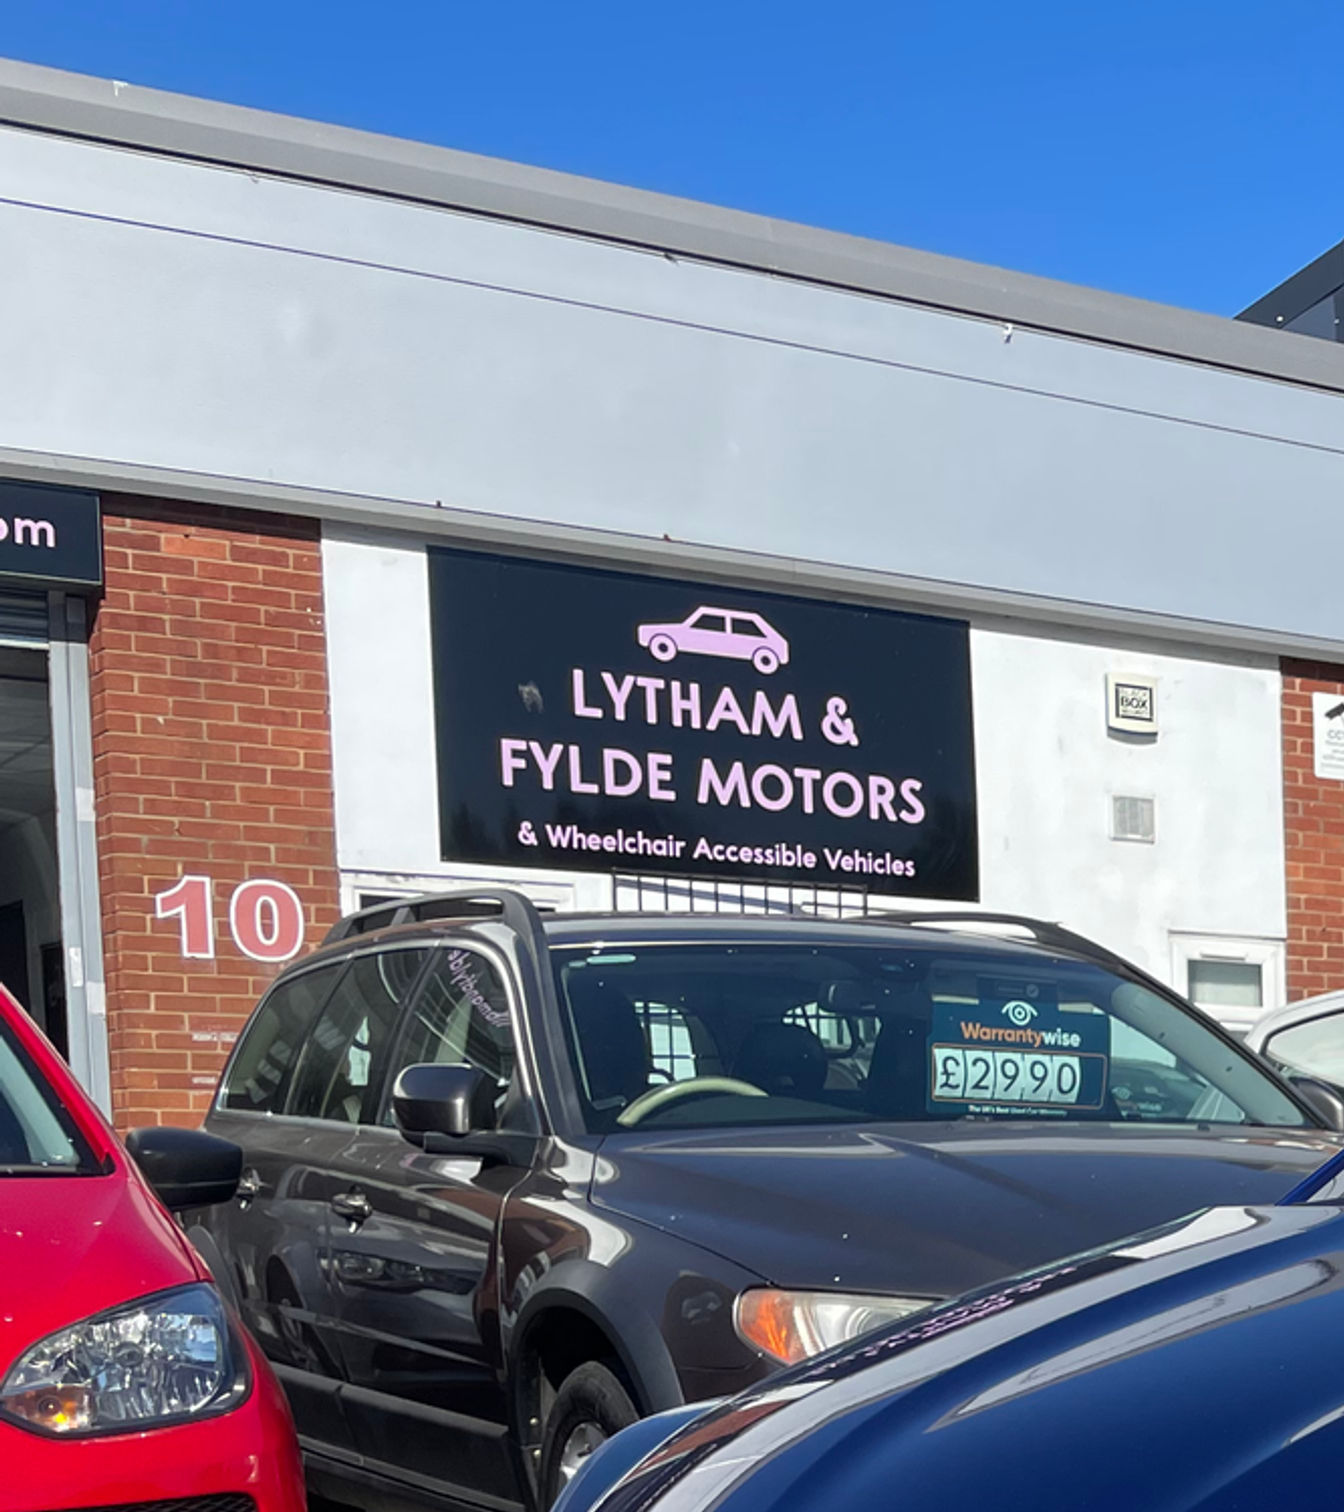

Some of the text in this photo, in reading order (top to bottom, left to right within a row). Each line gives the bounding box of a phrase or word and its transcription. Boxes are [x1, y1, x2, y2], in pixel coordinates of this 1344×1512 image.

[572, 668, 859, 746] LYTHAM &
[500, 738, 926, 824] FYLDE MOTORS
[518, 821, 916, 877] & Wheelchair Accessible Vehicles
[155, 874, 305, 962] 10
[960, 1021, 1081, 1048] Warrantywise
[939, 1055, 1077, 1095] £2990
